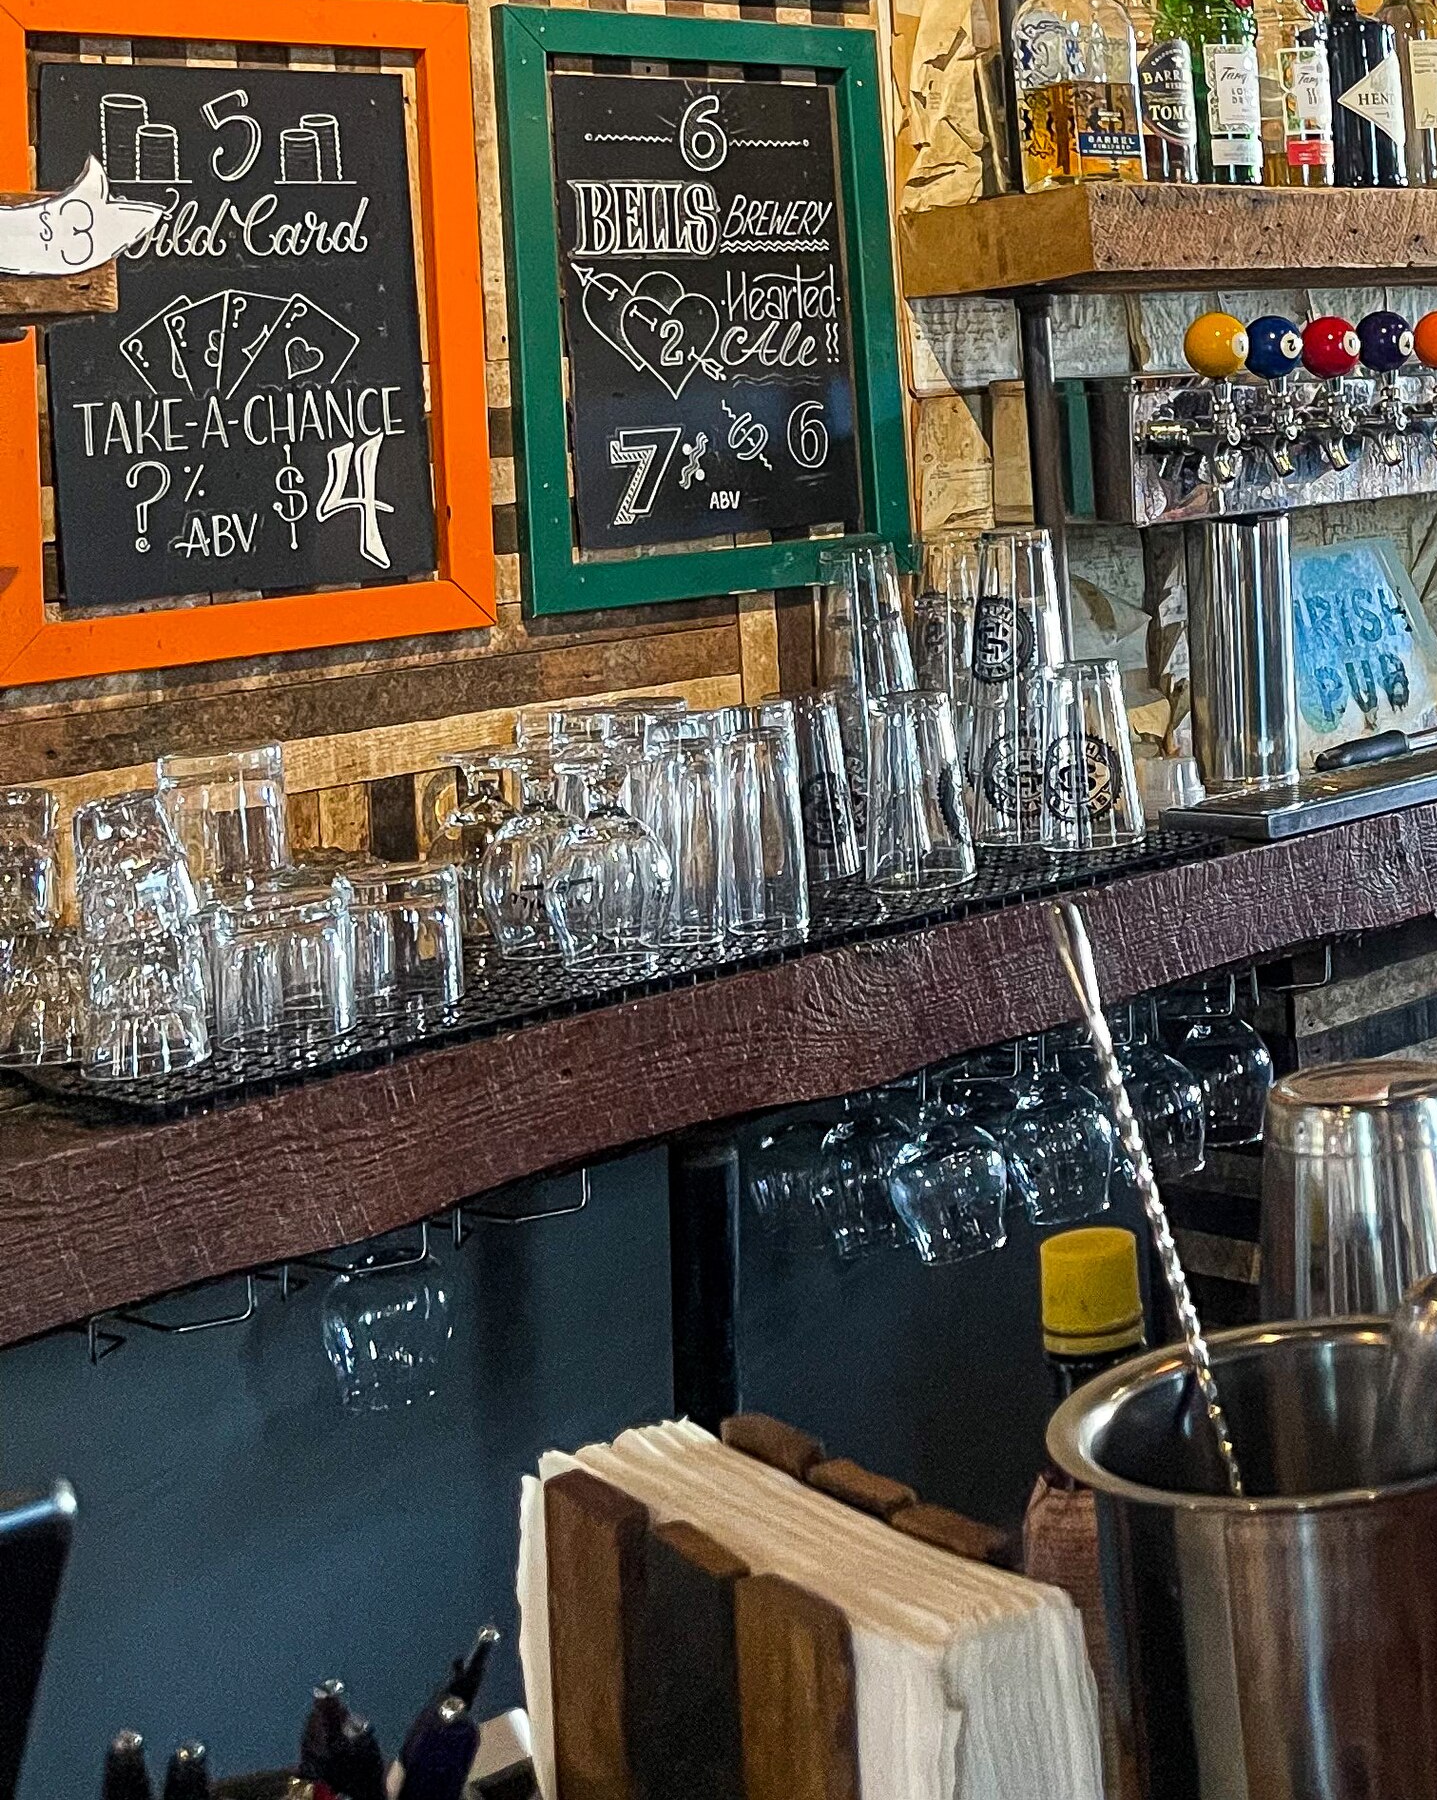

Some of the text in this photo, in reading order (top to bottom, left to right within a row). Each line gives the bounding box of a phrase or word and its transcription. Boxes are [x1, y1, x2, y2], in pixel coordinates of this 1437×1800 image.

[201, 89, 262, 182] 5
[679, 95, 727, 171] 6
[39, 198, 93, 265] $3
[123, 188, 369, 258] ild Card
[722, 193, 832, 240] BREWERY
[659, 264, 836, 366] 2 Hearted
[72, 386, 406, 456] TAKE-A-CHANCE
[273, 434, 394, 569] $4
[709, 490, 741, 510] ABV
[175, 513, 257, 558] ABV
[1314, 653, 1410, 723] PUB
